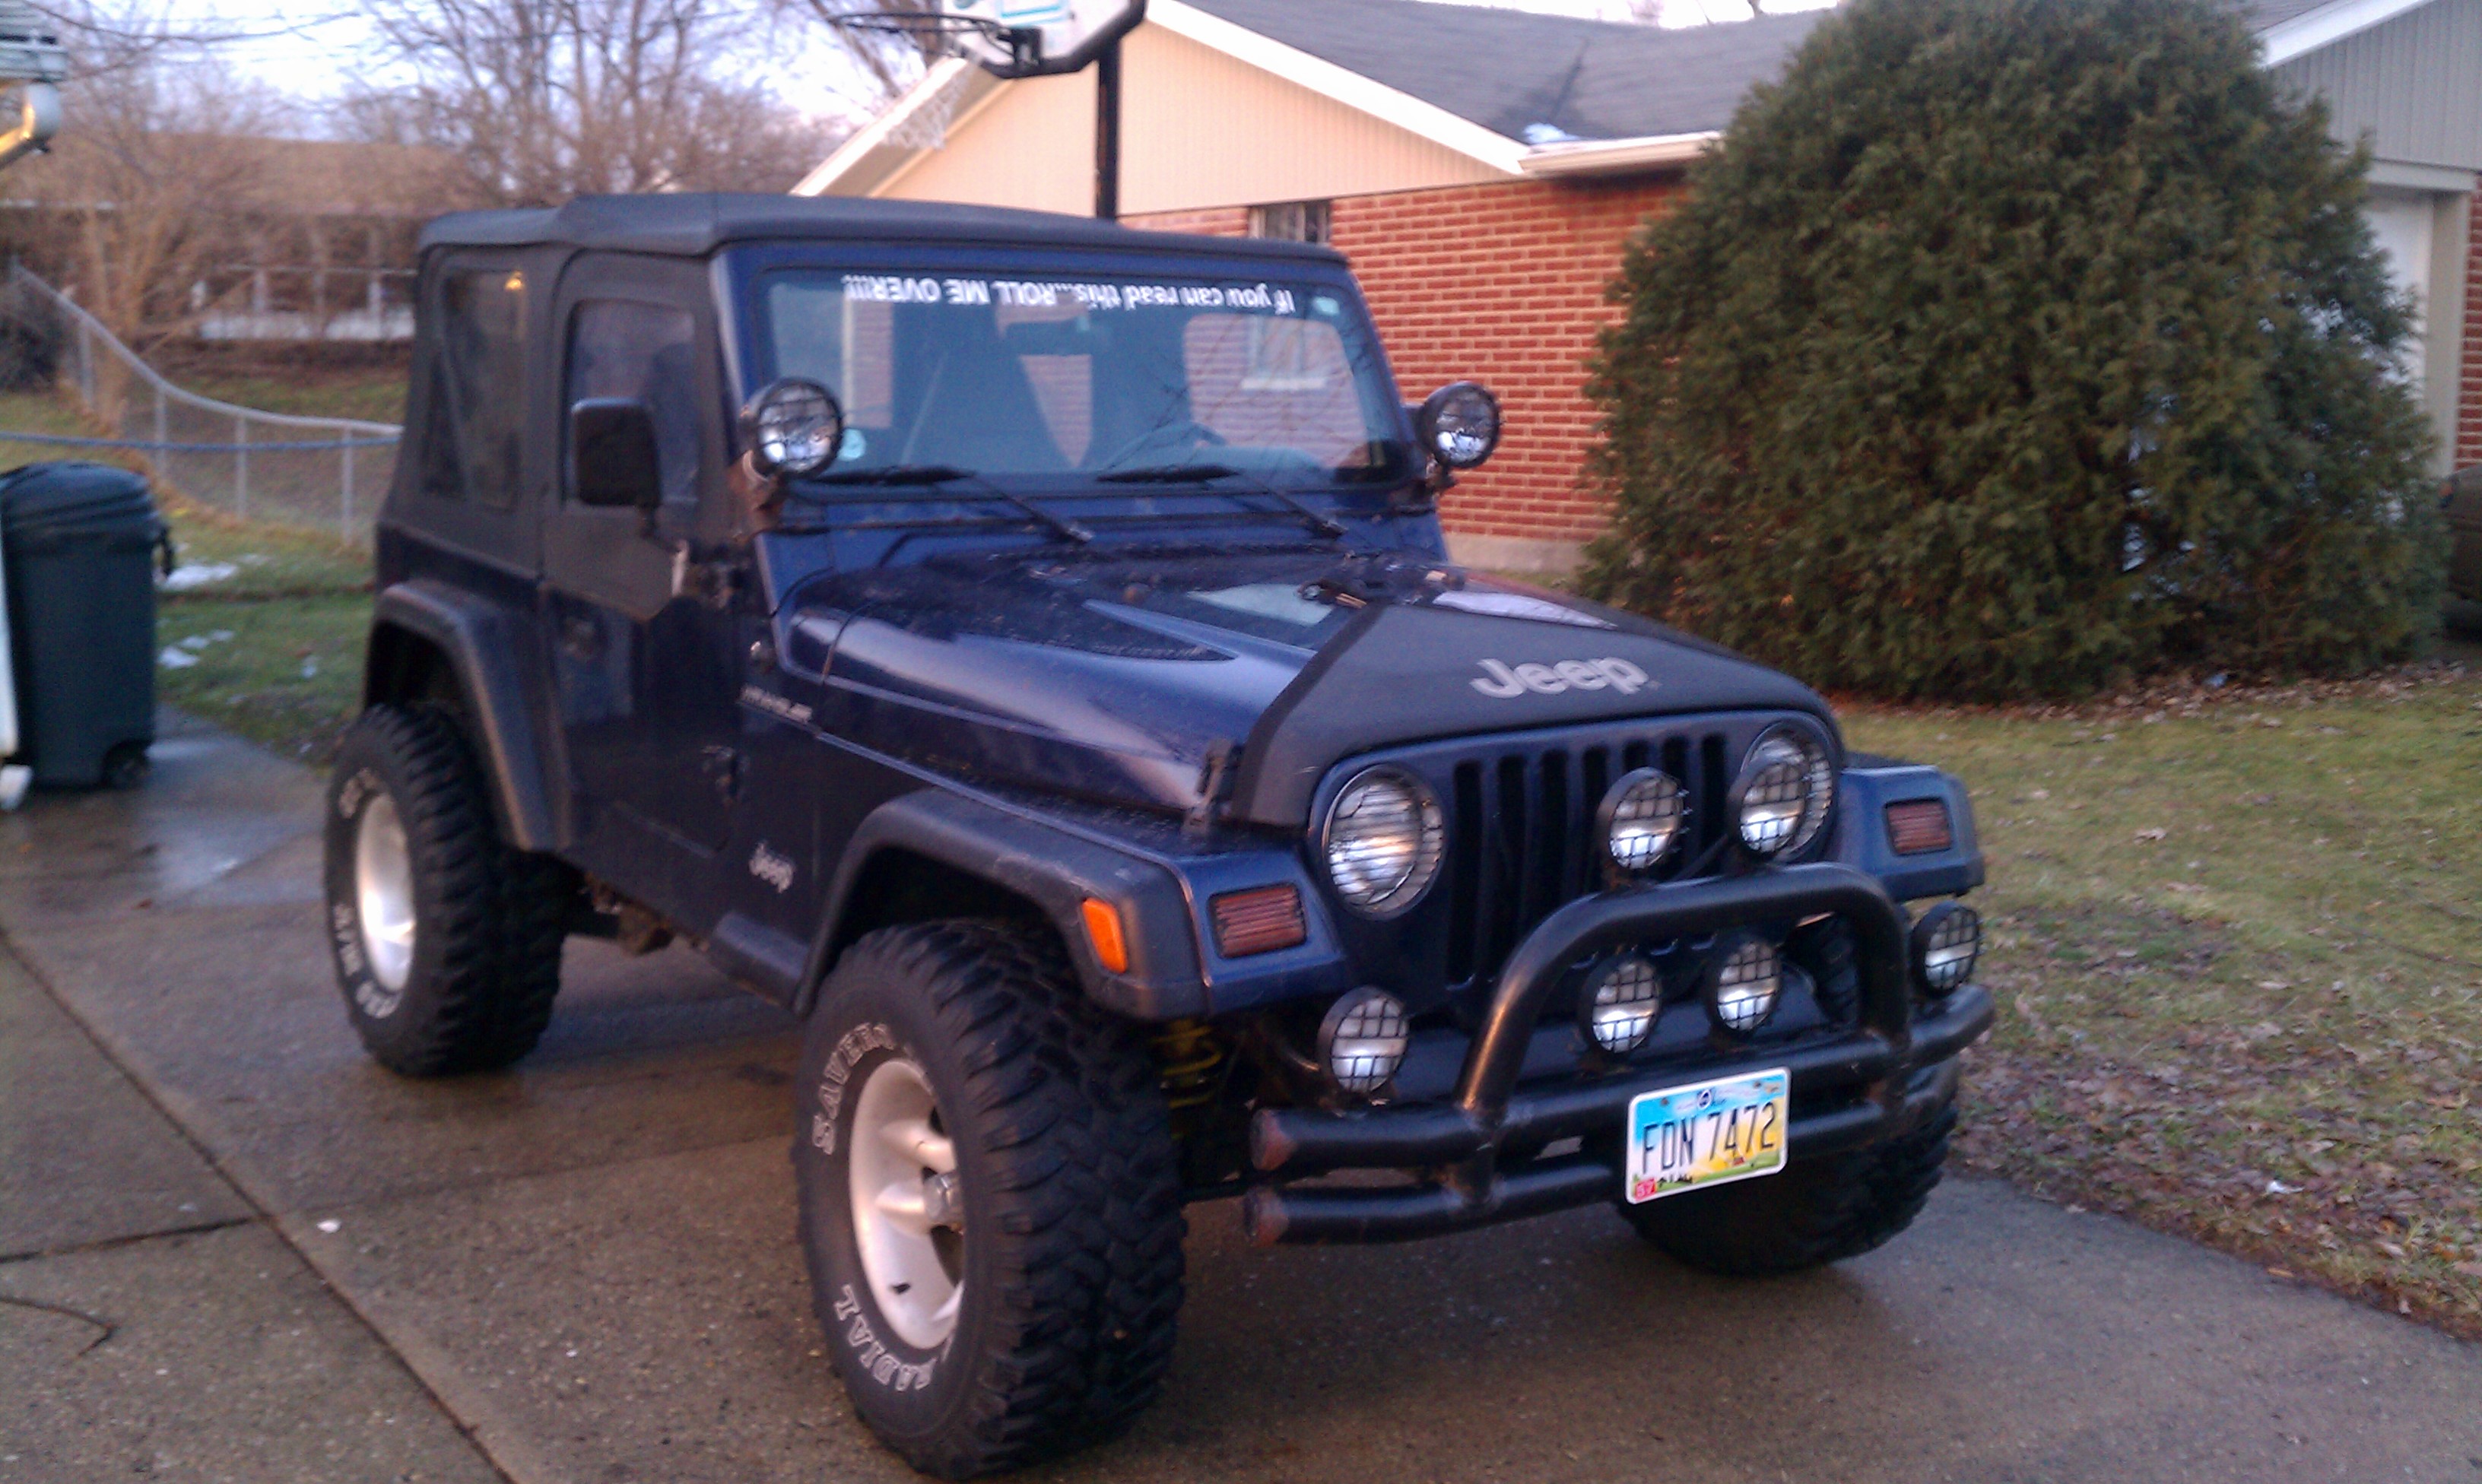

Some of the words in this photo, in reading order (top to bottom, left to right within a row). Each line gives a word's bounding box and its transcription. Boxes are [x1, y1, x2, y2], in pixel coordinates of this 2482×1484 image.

[942, 278, 991, 305] ME
[1121, 284, 1179, 310] read
[1179, 286, 1225, 306] can
[1225, 282, 1272, 308] you
[1274, 288, 1297, 315] If
[1469, 656, 1651, 699] Jeep
[1708, 1101, 1776, 1162] 7472
